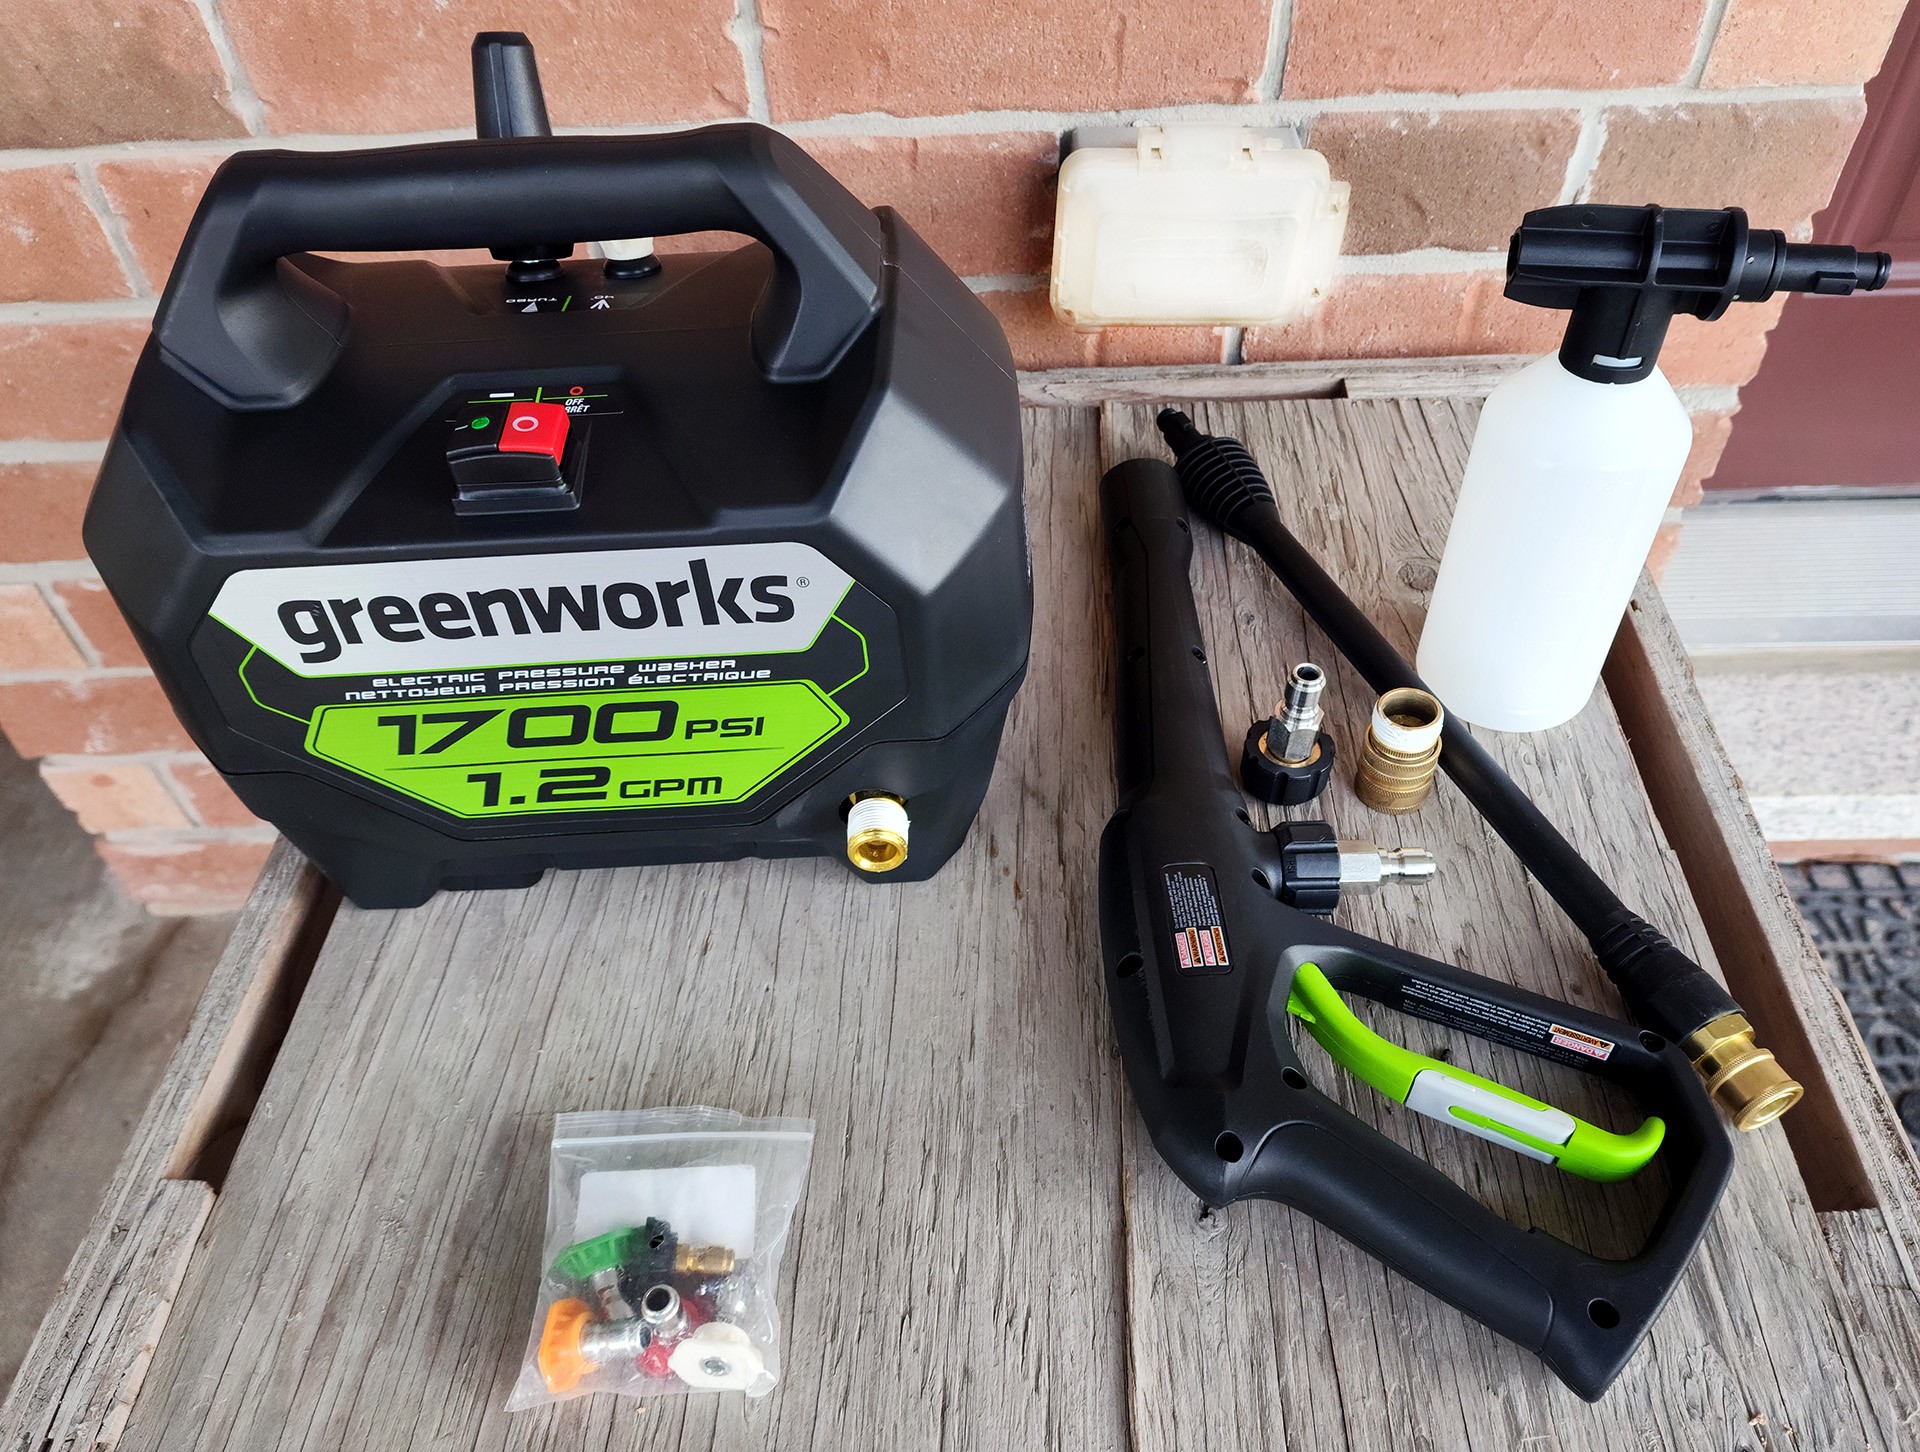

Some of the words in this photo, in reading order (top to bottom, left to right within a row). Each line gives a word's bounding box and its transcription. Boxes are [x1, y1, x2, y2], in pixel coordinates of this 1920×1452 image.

[565, 404, 590, 413] RRÊT
[276, 558, 795, 664] greenworks
[372, 672, 485, 688] ELECTRIC
[498, 664, 624, 680] PRESSURE
[638, 659, 736, 673] WASHER
[345, 684, 486, 700] NETTOYEUR
[500, 677, 614, 691] PRESSION
[378, 700, 679, 756] 1700
[685, 716, 765, 740] PSI
[466, 766, 611, 807] 1.2
[620, 776, 722, 798] GPM
[1177, 934, 1188, 958] DANGER
[1553, 1036, 1594, 1054] DANGER
